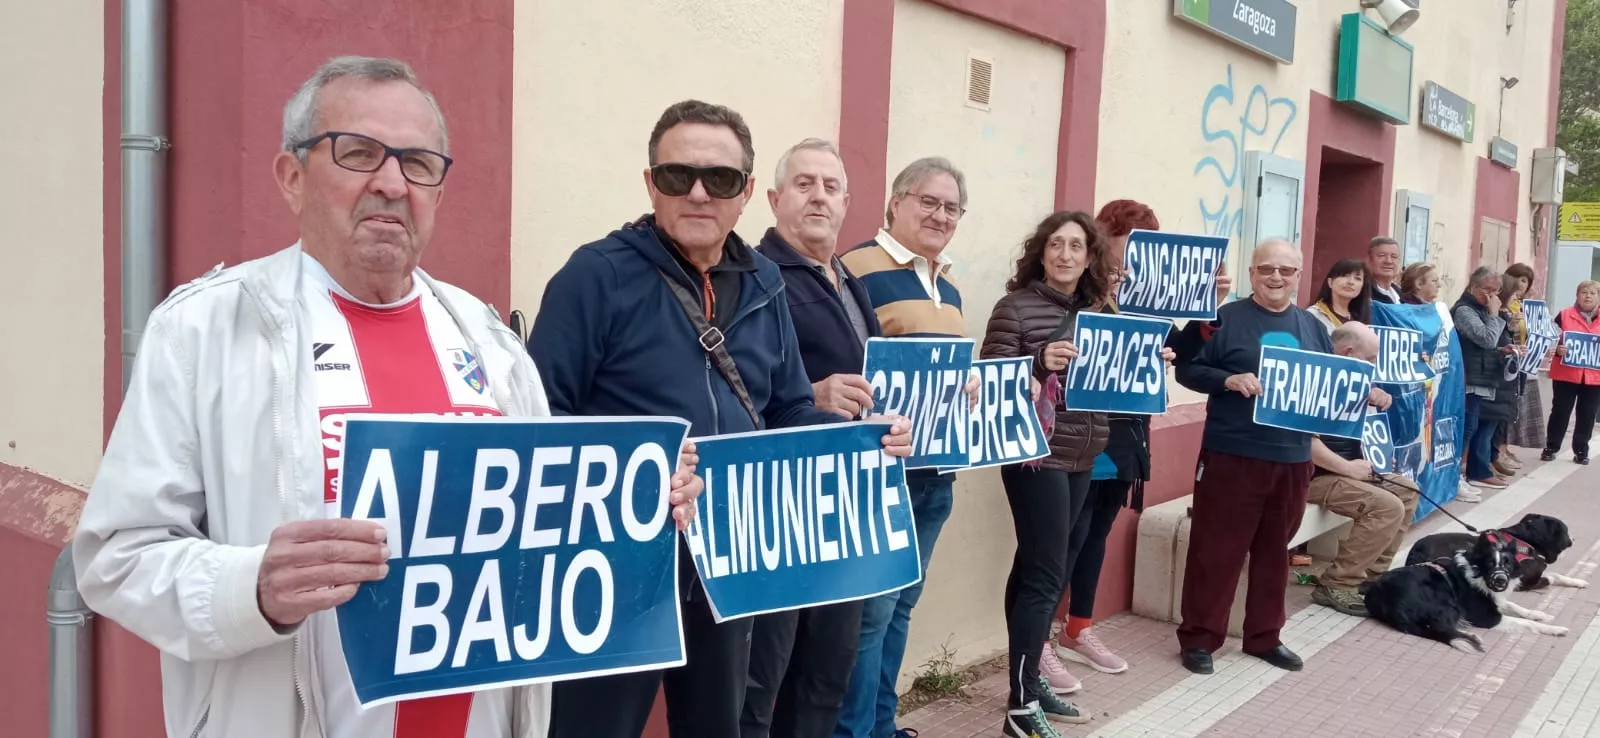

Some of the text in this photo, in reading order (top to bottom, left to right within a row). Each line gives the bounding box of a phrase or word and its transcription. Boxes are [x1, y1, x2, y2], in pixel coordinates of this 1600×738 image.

[1233, 0, 1276, 36] Zaragoza
[1070, 327, 1163, 395] PIRACES
[1262, 358, 1371, 422] TRAMACED
[1376, 328, 1427, 381] URBE
[969, 361, 1038, 464] BRES
[350, 442, 671, 560] ALBERO
[687, 448, 909, 580] ALMUNIENTE
[393, 549, 614, 676] BAJO
